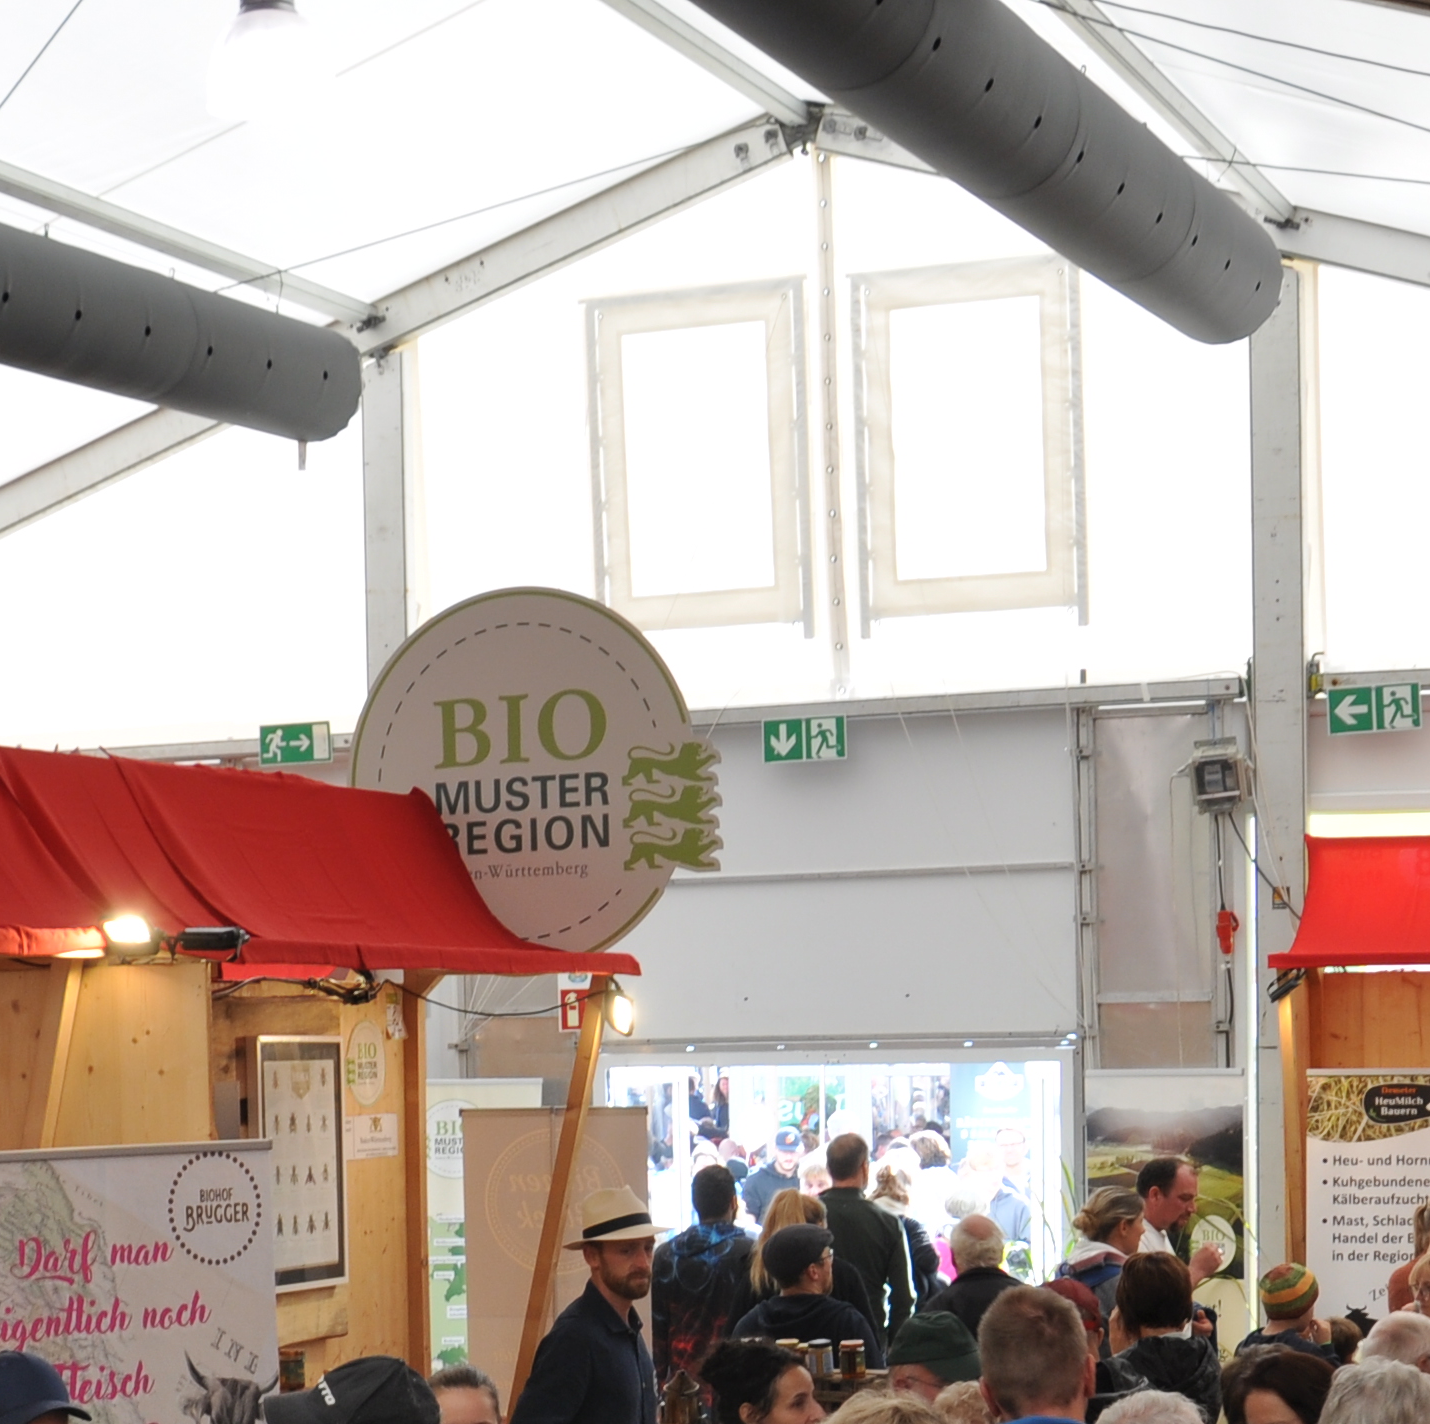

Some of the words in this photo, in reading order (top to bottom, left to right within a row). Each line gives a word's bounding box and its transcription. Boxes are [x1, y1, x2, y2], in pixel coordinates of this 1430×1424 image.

[433, 688, 607, 770] BIO
[435, 771, 610, 816] MUSTER
[357, 1042, 377, 1059] BIO
[1381, 1086, 1417, 1094] Demeter
[1375, 1096, 1423, 1106] HeuMilch
[1380, 1106, 1418, 1116] Bauern
[434, 1137, 463, 1148] MUST
[1332, 1155, 1363, 1166] Heu-
[1367, 1154, 1392, 1166] und
[1332, 1176, 1430, 1190] Kuhgebundene
[200, 1188, 233, 1203] BIOHOF
[1332, 1216, 1369, 1228] Mast,
[1373, 1215, 1413, 1226] Schlac
[1202, 1230, 1225, 1241] BIO
[1332, 1233, 1378, 1244] Handel
[1382, 1233, 1403, 1244] der
[10, 1229, 97, 1286] Darf
[111, 1241, 174, 1266] man
[1332, 1250, 1344, 1261] in
[1347, 1250, 1369, 1261] der
[142, 1290, 212, 1329] noch
